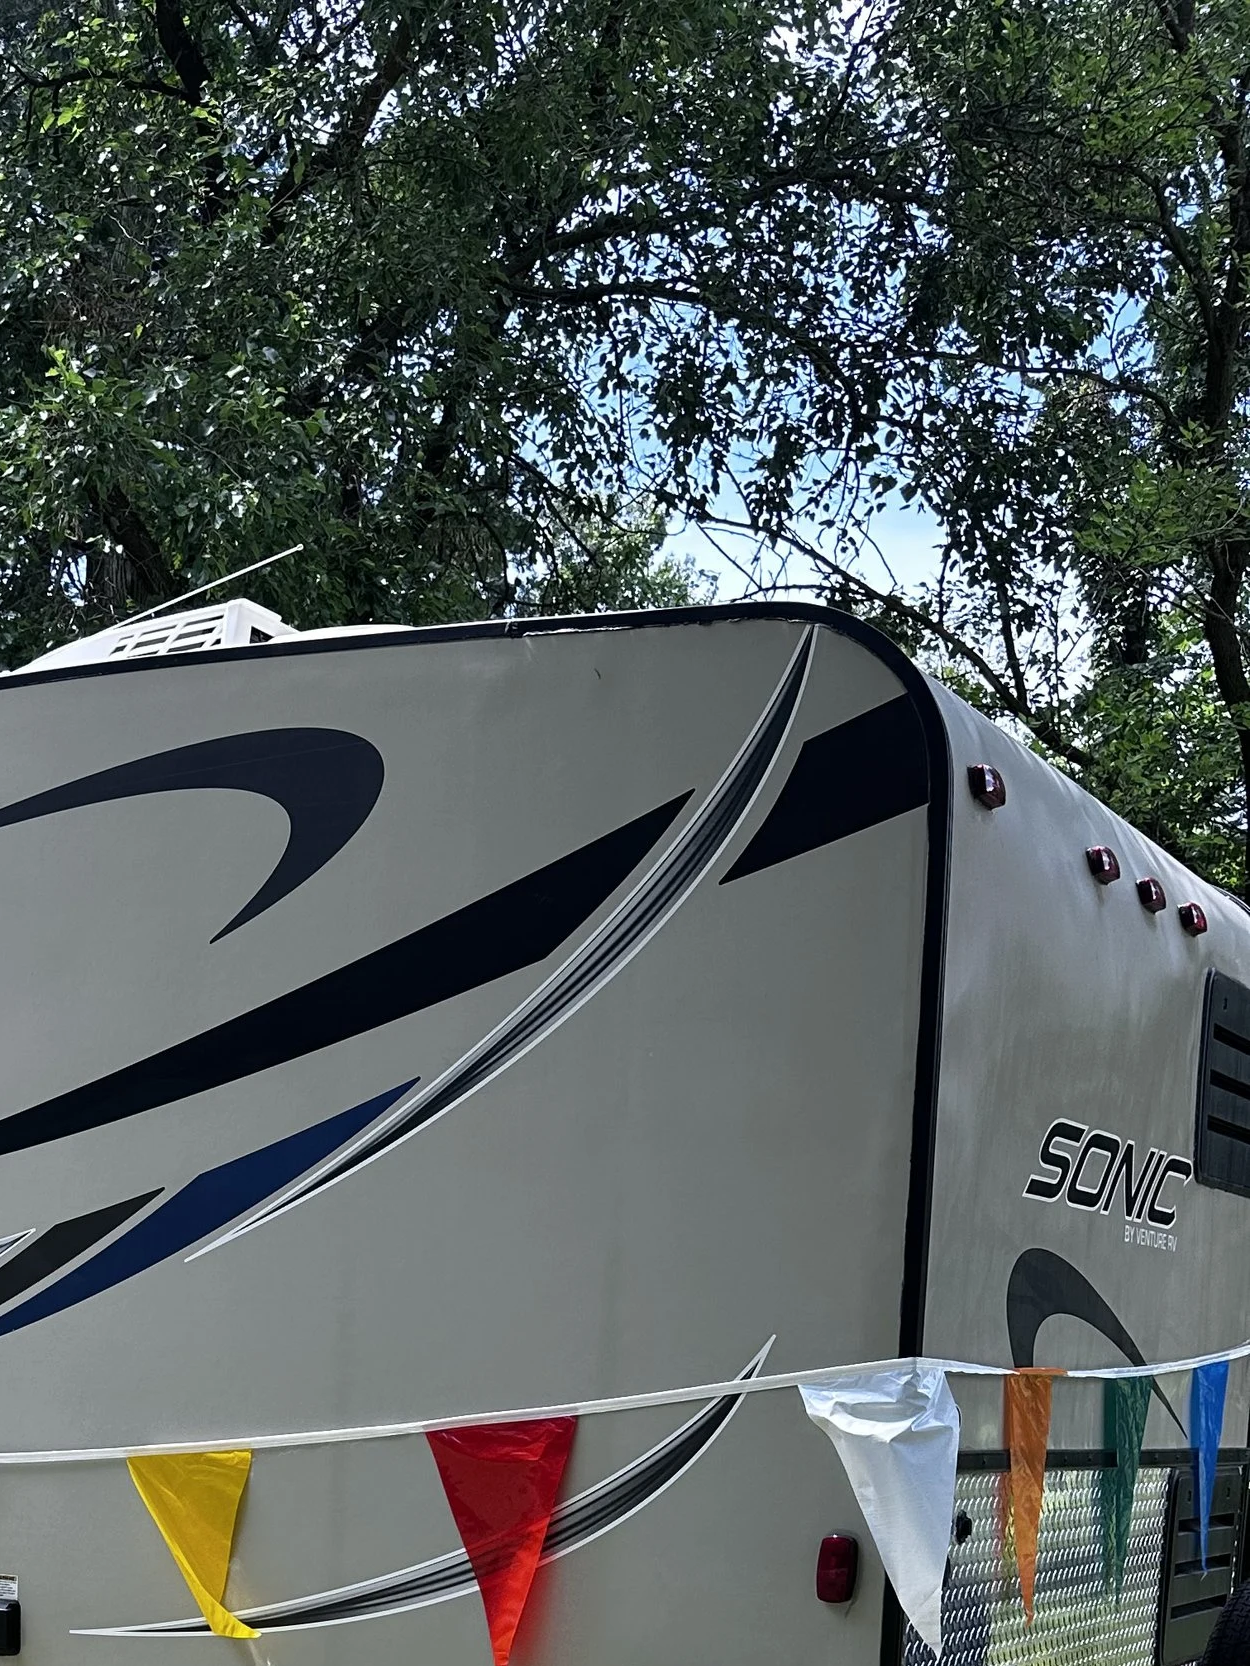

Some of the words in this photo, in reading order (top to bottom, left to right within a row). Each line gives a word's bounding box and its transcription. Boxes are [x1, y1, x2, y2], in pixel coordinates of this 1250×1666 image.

[1022, 1117, 1194, 1230] SONIC
[1124, 1224, 1135, 1243] BY
[1136, 1226, 1167, 1250] VENTURE
[1167, 1234, 1178, 1252] RV
